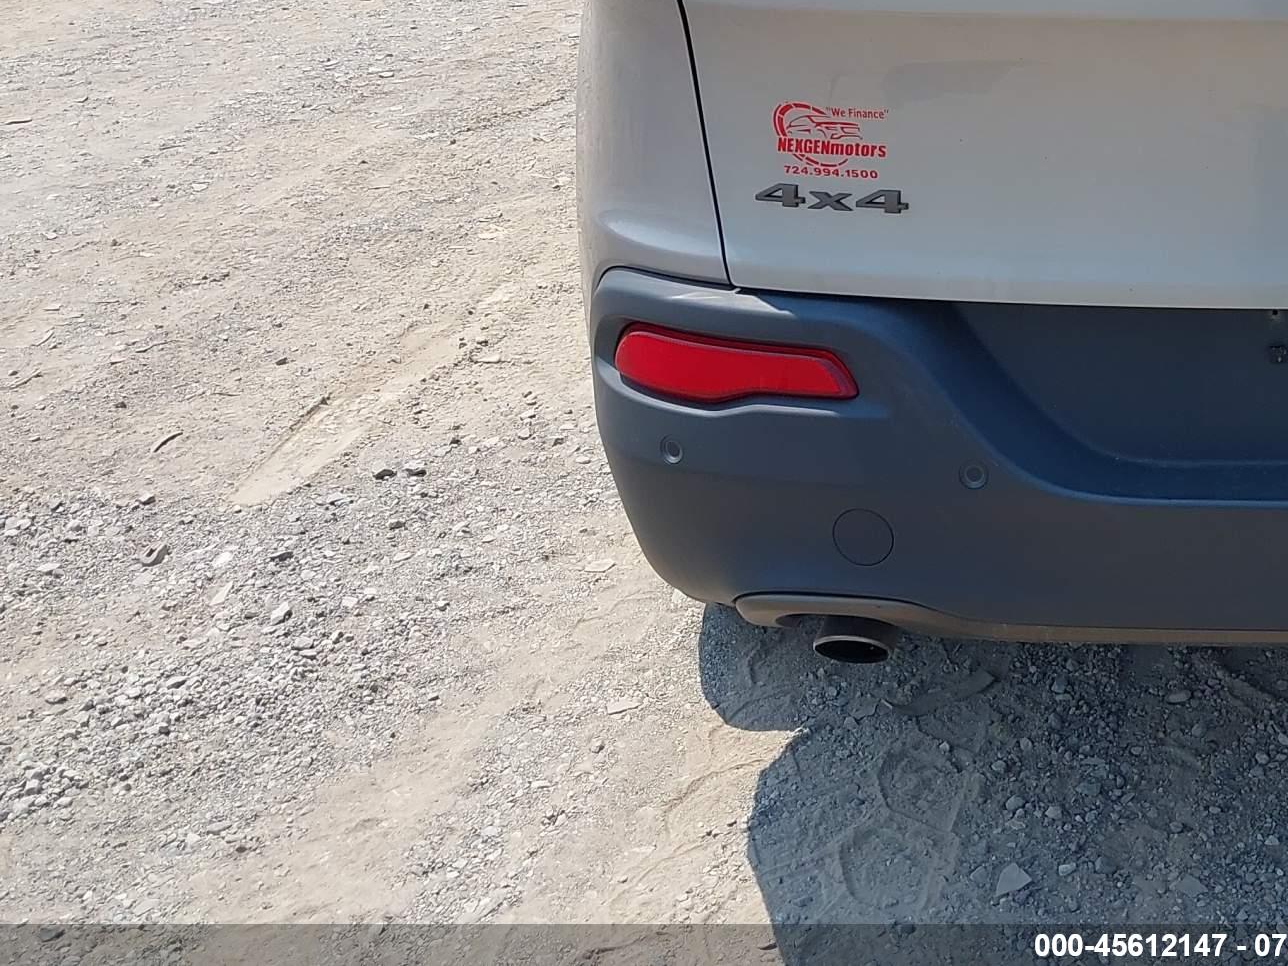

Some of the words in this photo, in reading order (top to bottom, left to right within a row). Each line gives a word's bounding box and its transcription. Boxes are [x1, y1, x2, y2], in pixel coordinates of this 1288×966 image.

[848, 108, 889, 119] Finance"
[777, 137, 887, 158] NEXGENmotors
[784, 165, 879, 179] 724.994.1500
[755, 183, 910, 214] 4x4
